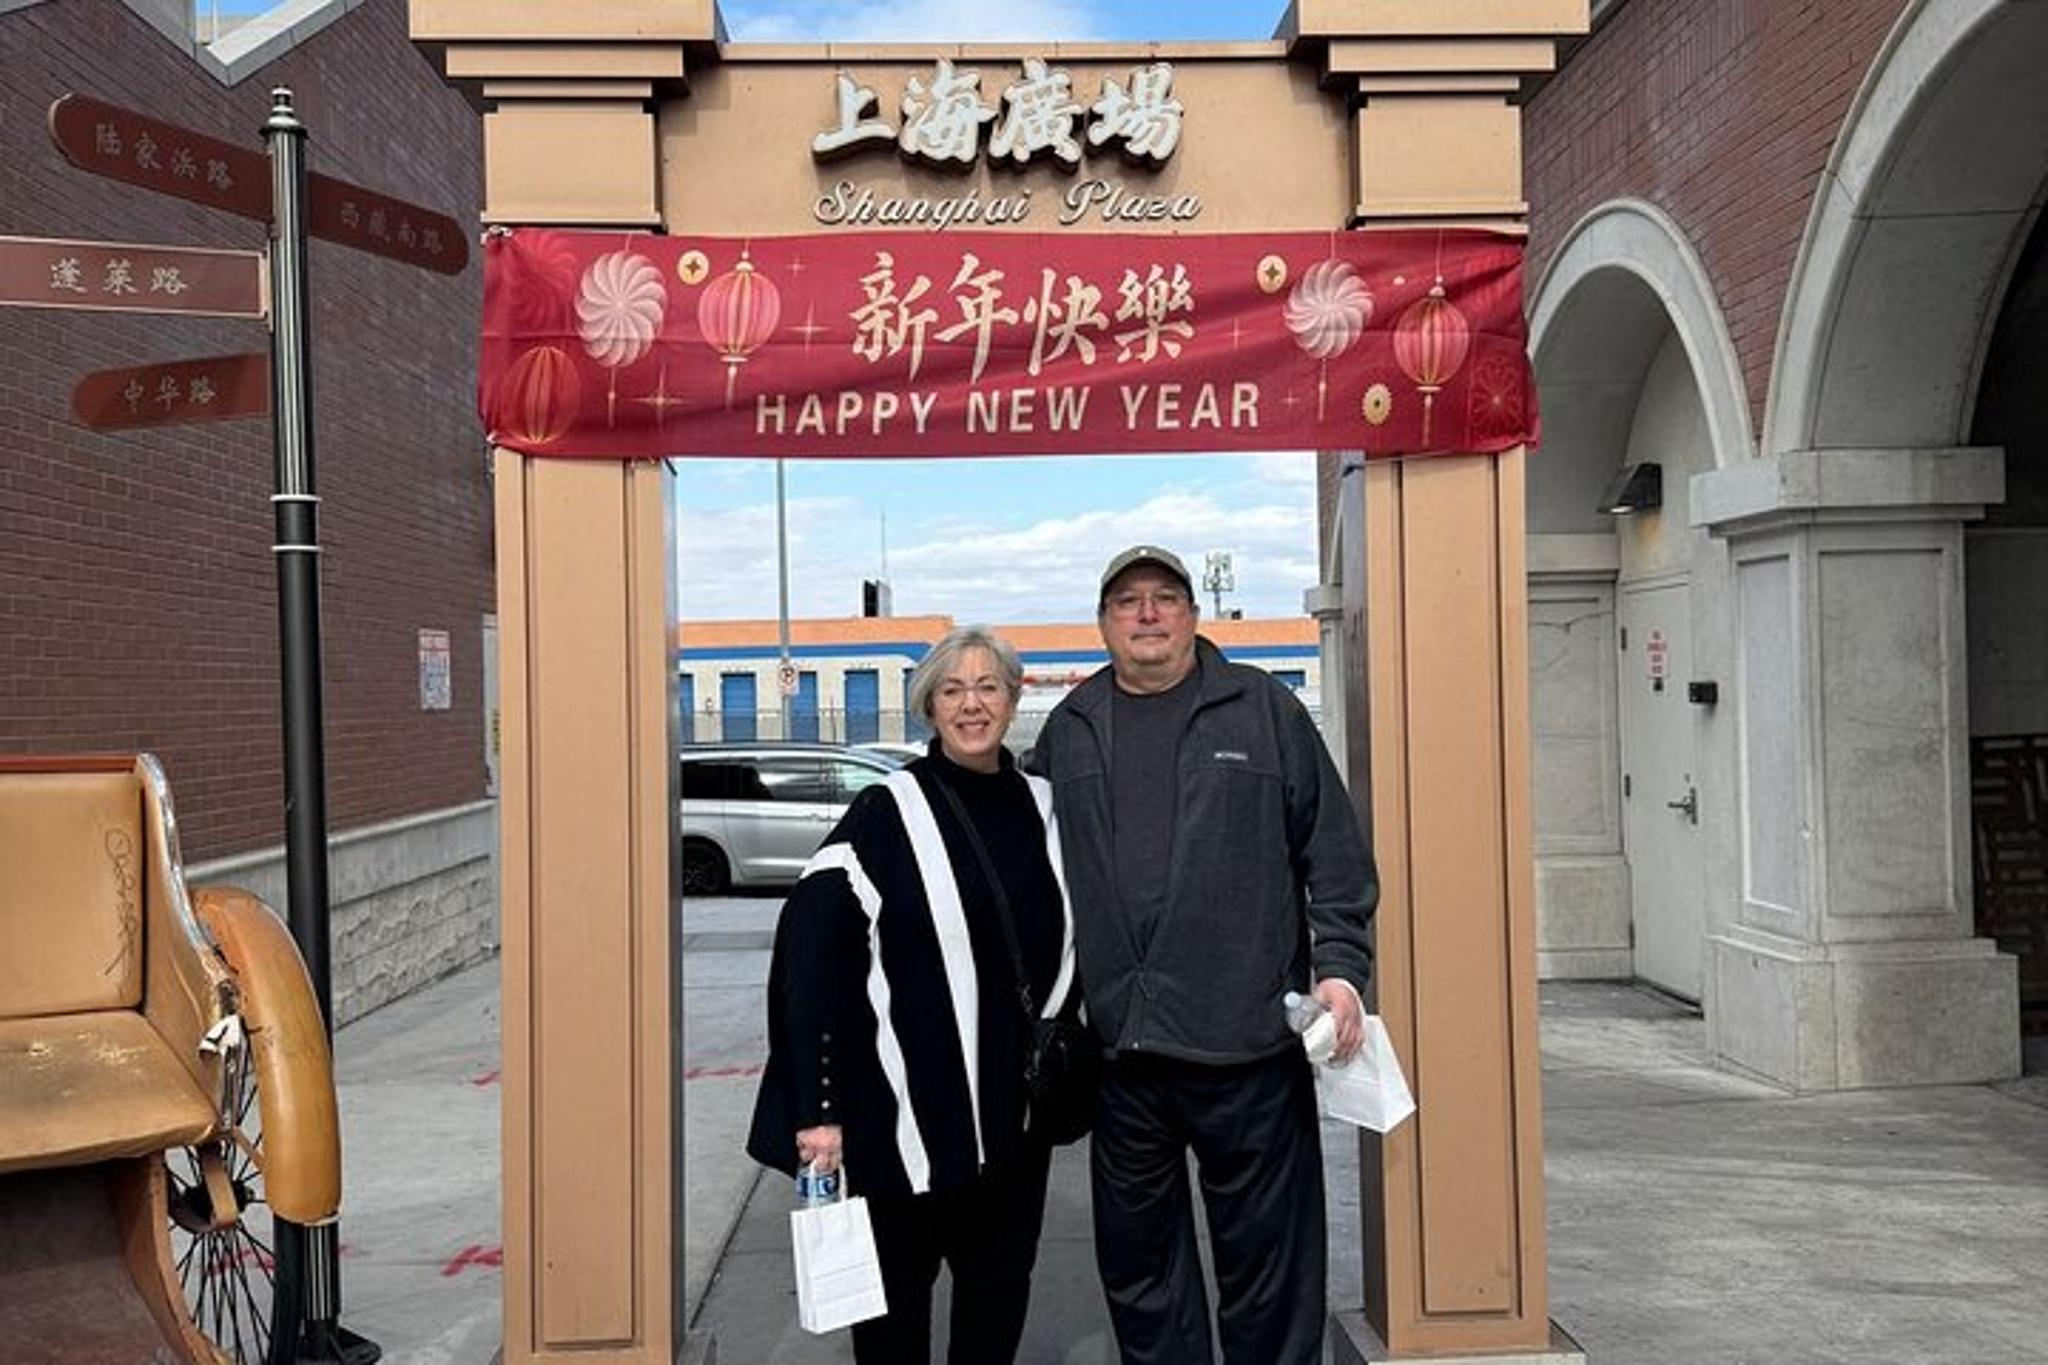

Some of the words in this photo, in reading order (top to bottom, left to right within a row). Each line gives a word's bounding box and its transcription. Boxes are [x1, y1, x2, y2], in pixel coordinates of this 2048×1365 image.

[812, 57, 1184, 171] 上海廣場
[813, 179, 1031, 230] Shanghai
[1059, 179, 1203, 225] Plaza
[848, 251, 1196, 384] 新年快樂
[124, 376, 216, 414] 中华路
[754, 391, 941, 435] HAPPY
[965, 384, 1092, 433] NEW
[1120, 382, 1261, 431] YEAR
